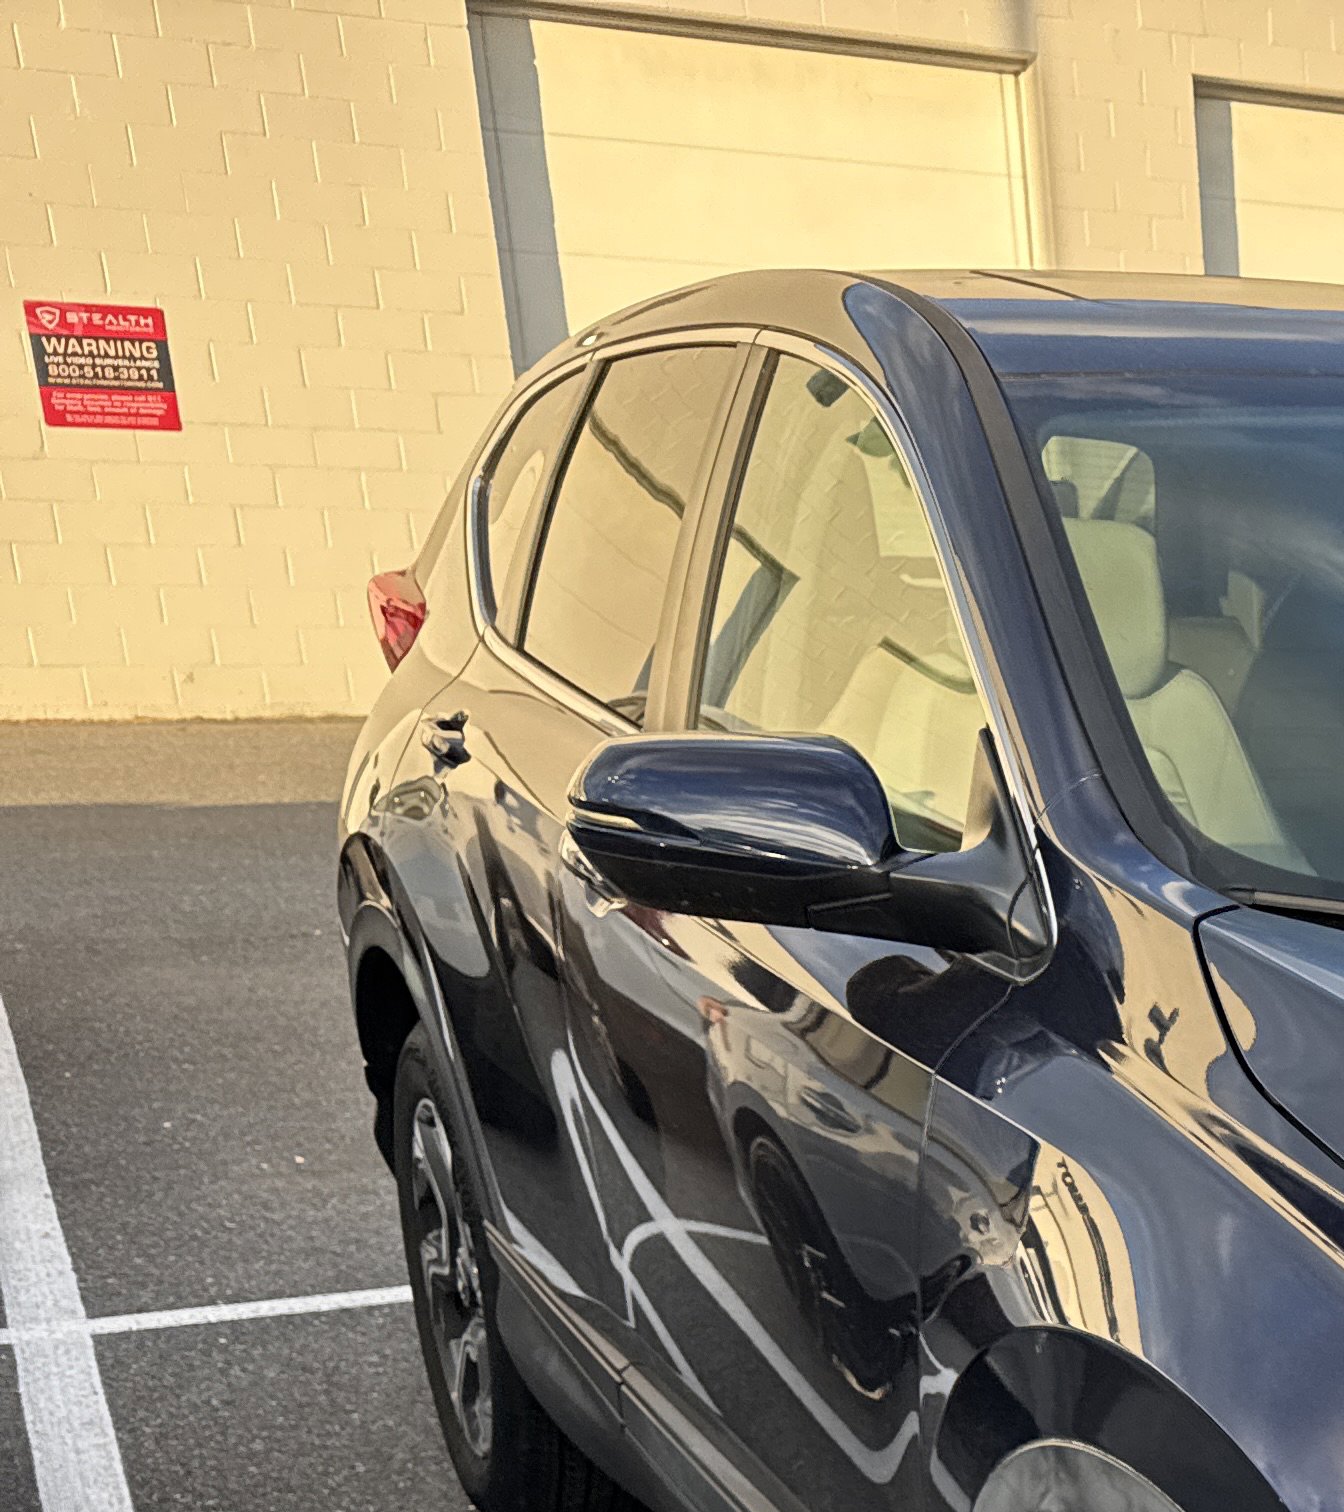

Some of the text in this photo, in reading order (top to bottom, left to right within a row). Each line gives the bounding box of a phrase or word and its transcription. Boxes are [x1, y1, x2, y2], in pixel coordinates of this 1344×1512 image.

[65, 311, 153, 326] STEALTH
[41, 336, 158, 358] WARNING
[44, 355, 64, 363] LIVE
[66, 356, 93, 365] VIDEO
